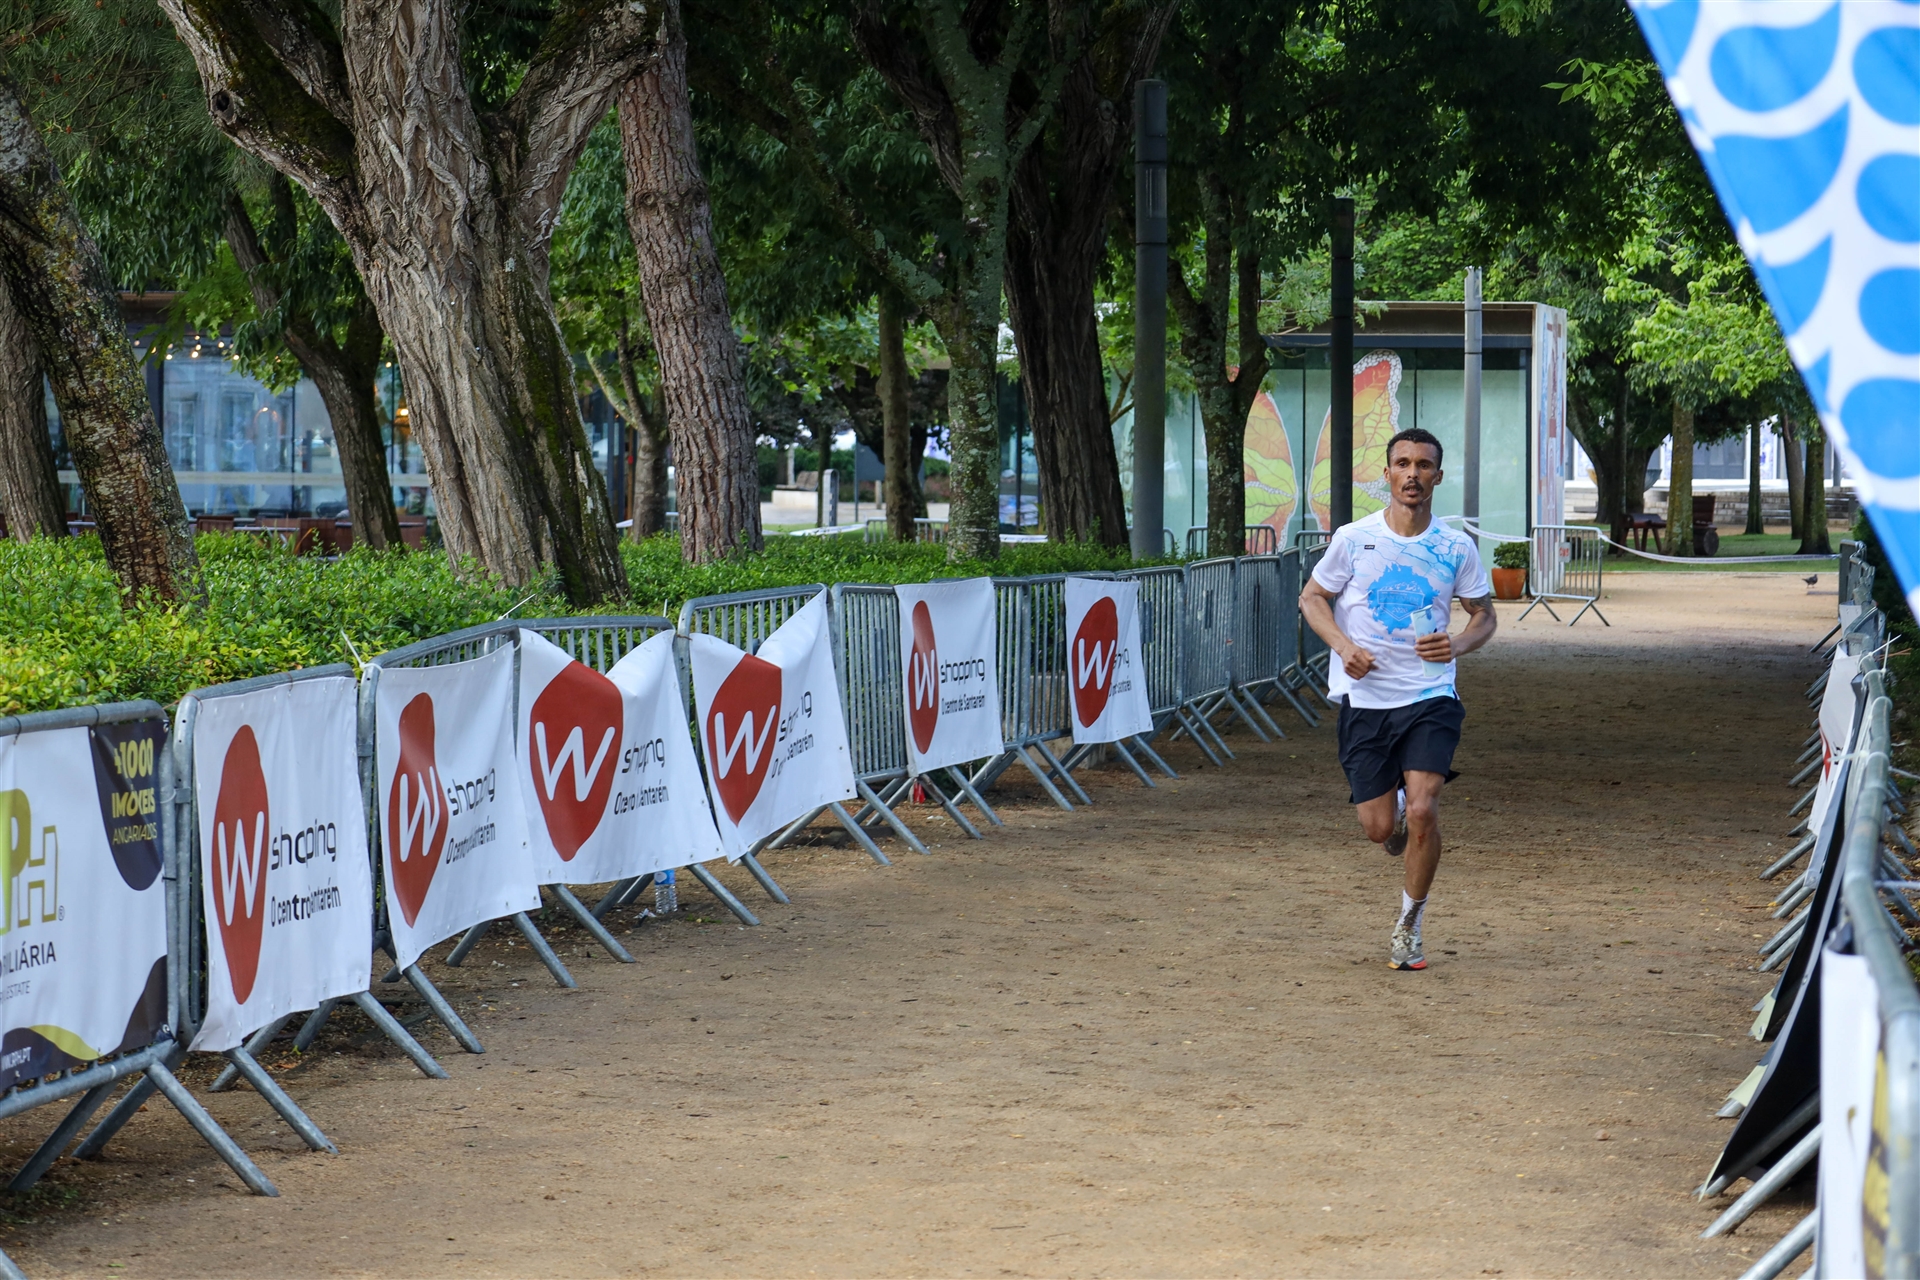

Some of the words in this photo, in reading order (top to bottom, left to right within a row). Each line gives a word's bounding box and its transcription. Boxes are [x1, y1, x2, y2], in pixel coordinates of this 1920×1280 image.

[914, 649, 936, 711] W
[941, 656, 985, 686] shopping
[1078, 638, 1116, 690] W
[535, 721, 616, 802] W
[715, 704, 777, 780] W
[400, 766, 440, 863] W
[218, 811, 265, 926] W
